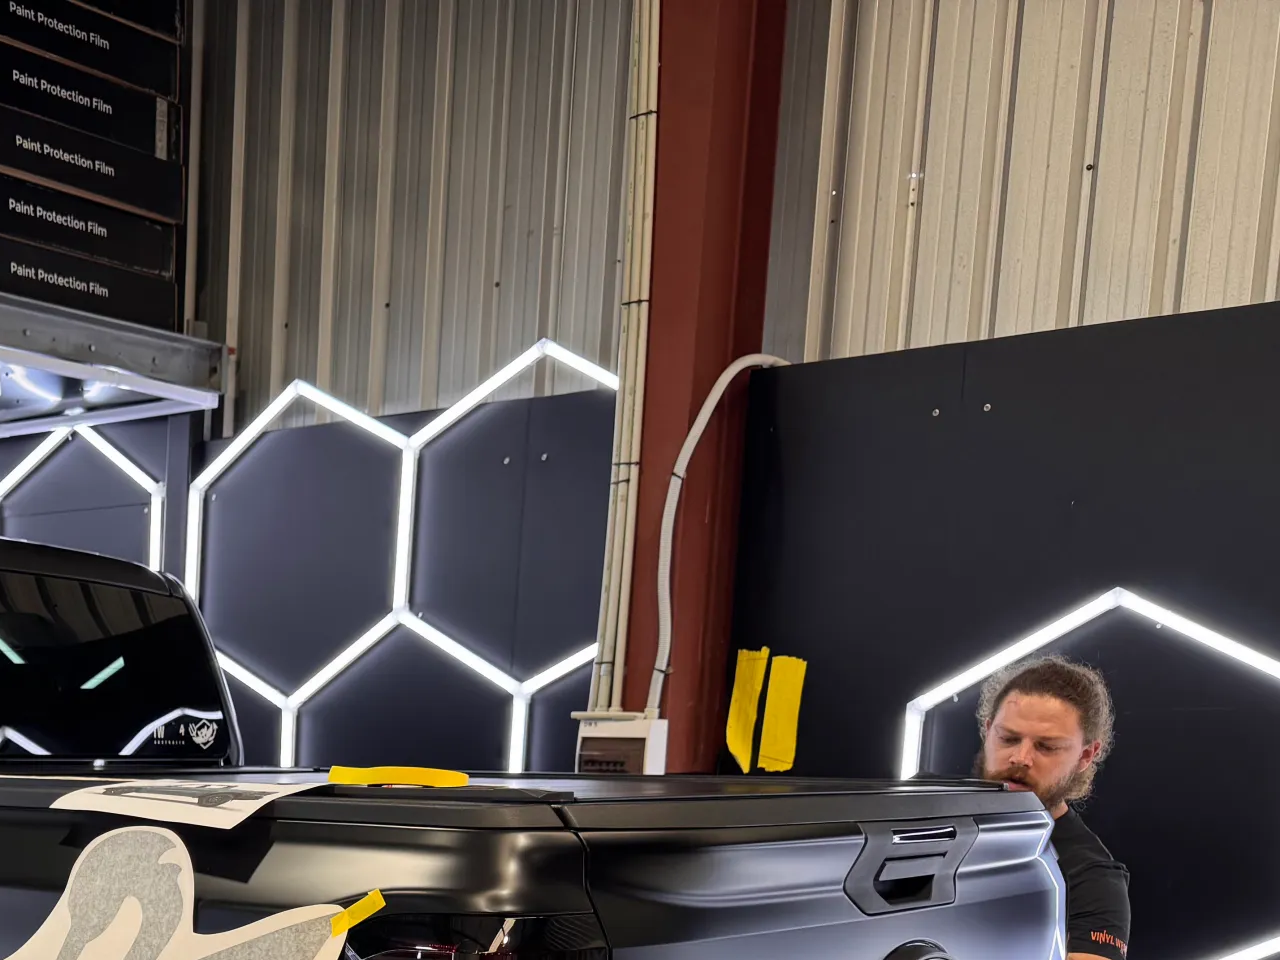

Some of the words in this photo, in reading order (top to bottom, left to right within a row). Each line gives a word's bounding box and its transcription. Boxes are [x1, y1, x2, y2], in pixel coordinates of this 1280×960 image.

[9, 1, 35, 21] Paint
[37, 12, 87, 42] Protection
[89, 33, 110, 50] Film
[12, 70, 38, 89] Paint
[40, 79, 91, 107] Protection
[92, 97, 113, 115] Film
[15, 134, 42, 153] Paint
[43, 144, 93, 170] Protection
[95, 160, 115, 177] Film
[8, 198, 34, 217] Paint
[36, 207, 85, 232] Protection
[87, 222, 108, 238] Film
[10, 261, 36, 280] Paint
[38, 270, 87, 293] Protection
[89, 282, 109, 298] Film
[1090, 929, 1115, 945] VINYL
